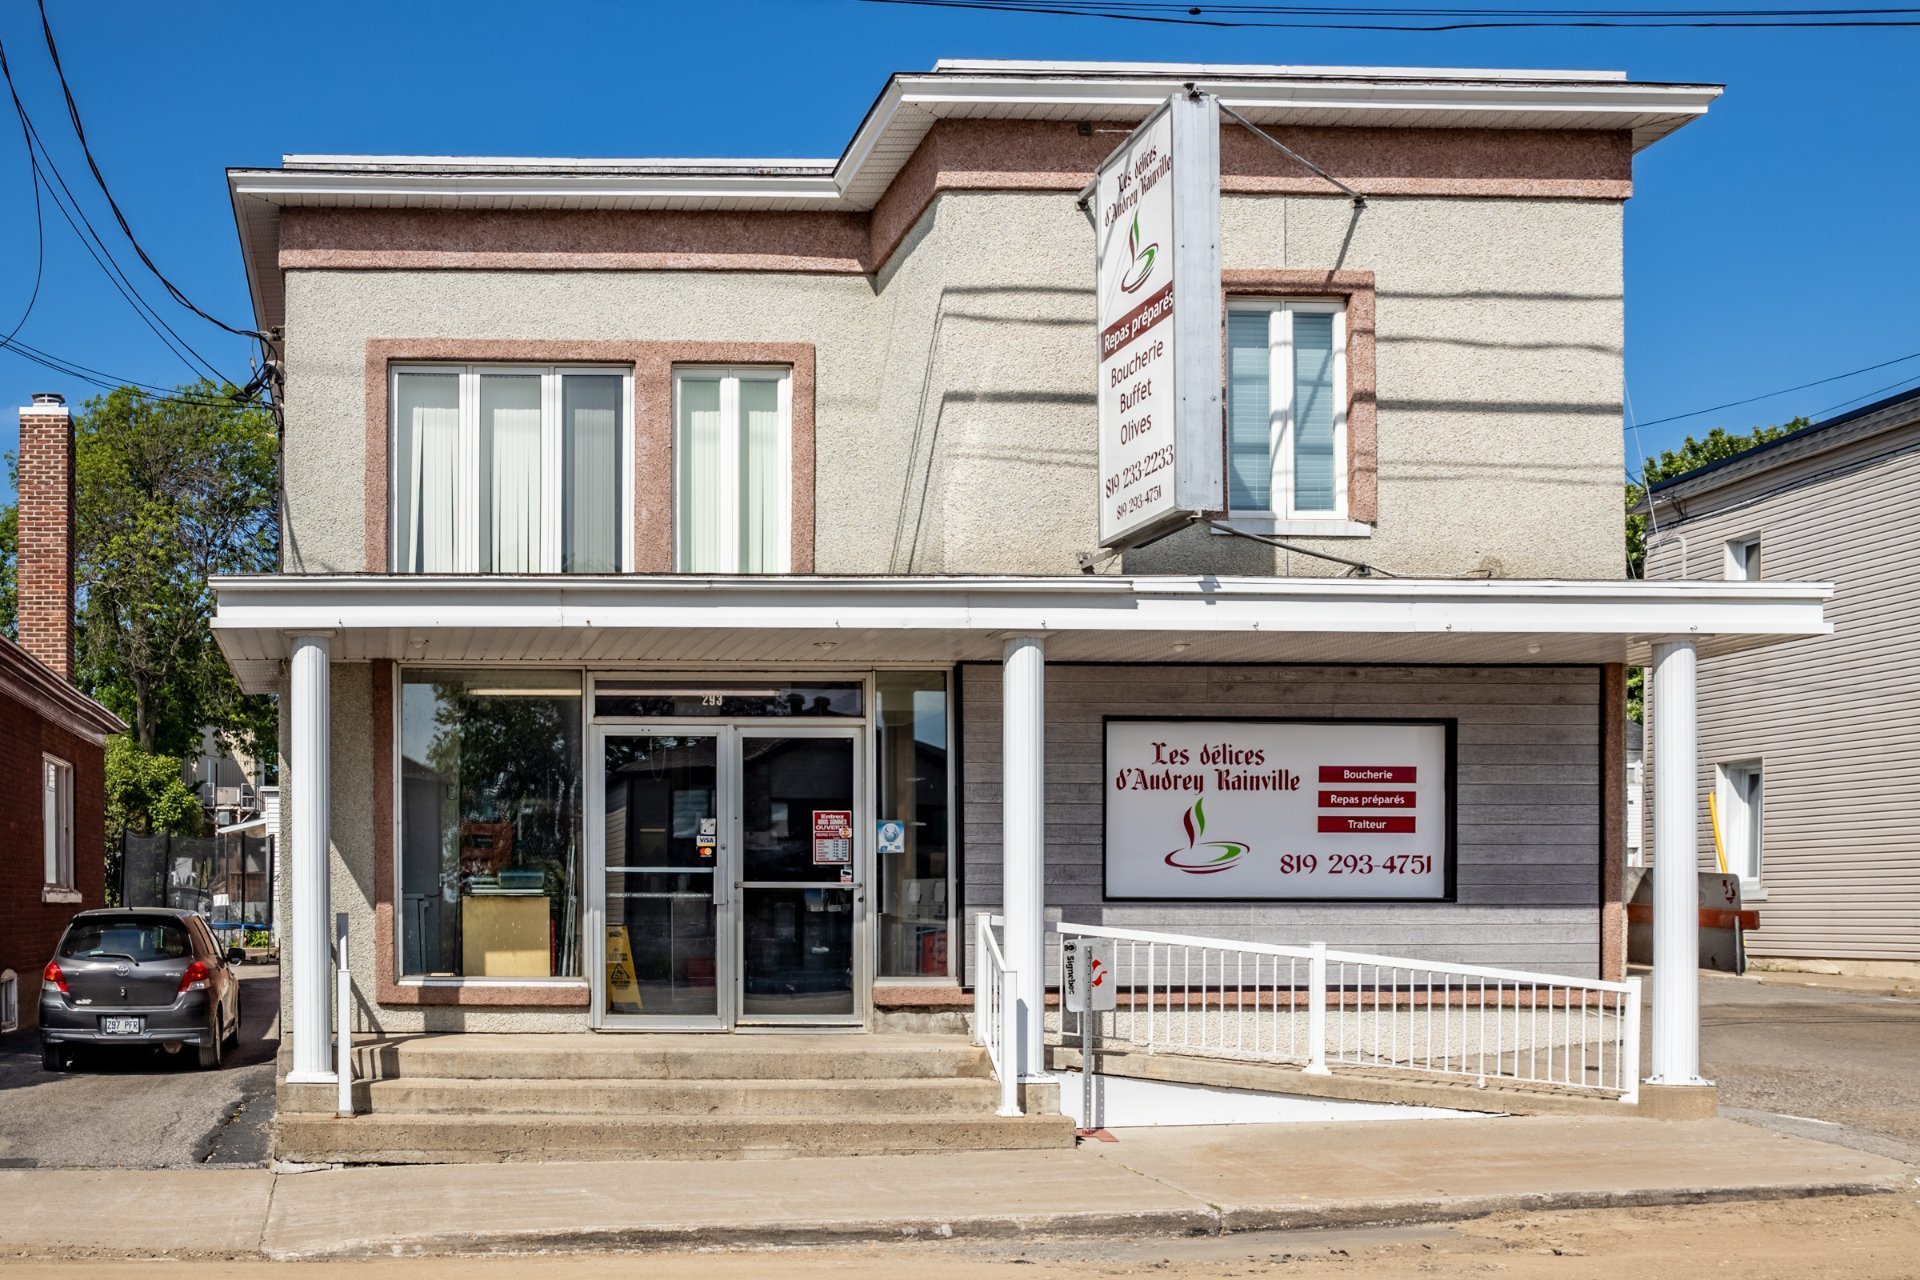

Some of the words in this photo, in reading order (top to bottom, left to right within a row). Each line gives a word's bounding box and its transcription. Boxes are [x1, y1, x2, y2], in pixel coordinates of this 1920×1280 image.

[1117, 171, 1132, 192] Les
[1134, 145, 1157, 179] délices
[1139, 153, 1172, 196] Rainville
[1104, 323, 1130, 353] Repas
[1131, 290, 1173, 338] préparés
[1111, 338, 1164, 389] Boucherie
[1120, 377, 1152, 414] Buffet
[1120, 413, 1152, 446] Olives
[1105, 473, 1120, 500] 819
[1122, 443, 1174, 490] 233-2233
[1116, 501, 1127, 521] 819
[1128, 483, 1162, 514] 293-4751
[702, 694, 722, 706] 293
[1151, 742, 1190, 765] Les
[1200, 742, 1265, 766] délices
[1214, 768, 1301, 792] Rainville
[1343, 769, 1393, 780] Boucherie
[1330, 794, 1360, 806] Repas
[1361, 794, 1406, 806] préparés
[1347, 819, 1387, 830] Traiteur
[1280, 854, 1318, 875] 819
[1328, 854, 1432, 875] 293-4751
[107, 1020, 120, 1030] Z97
[124, 1020, 138, 1030] PFR
